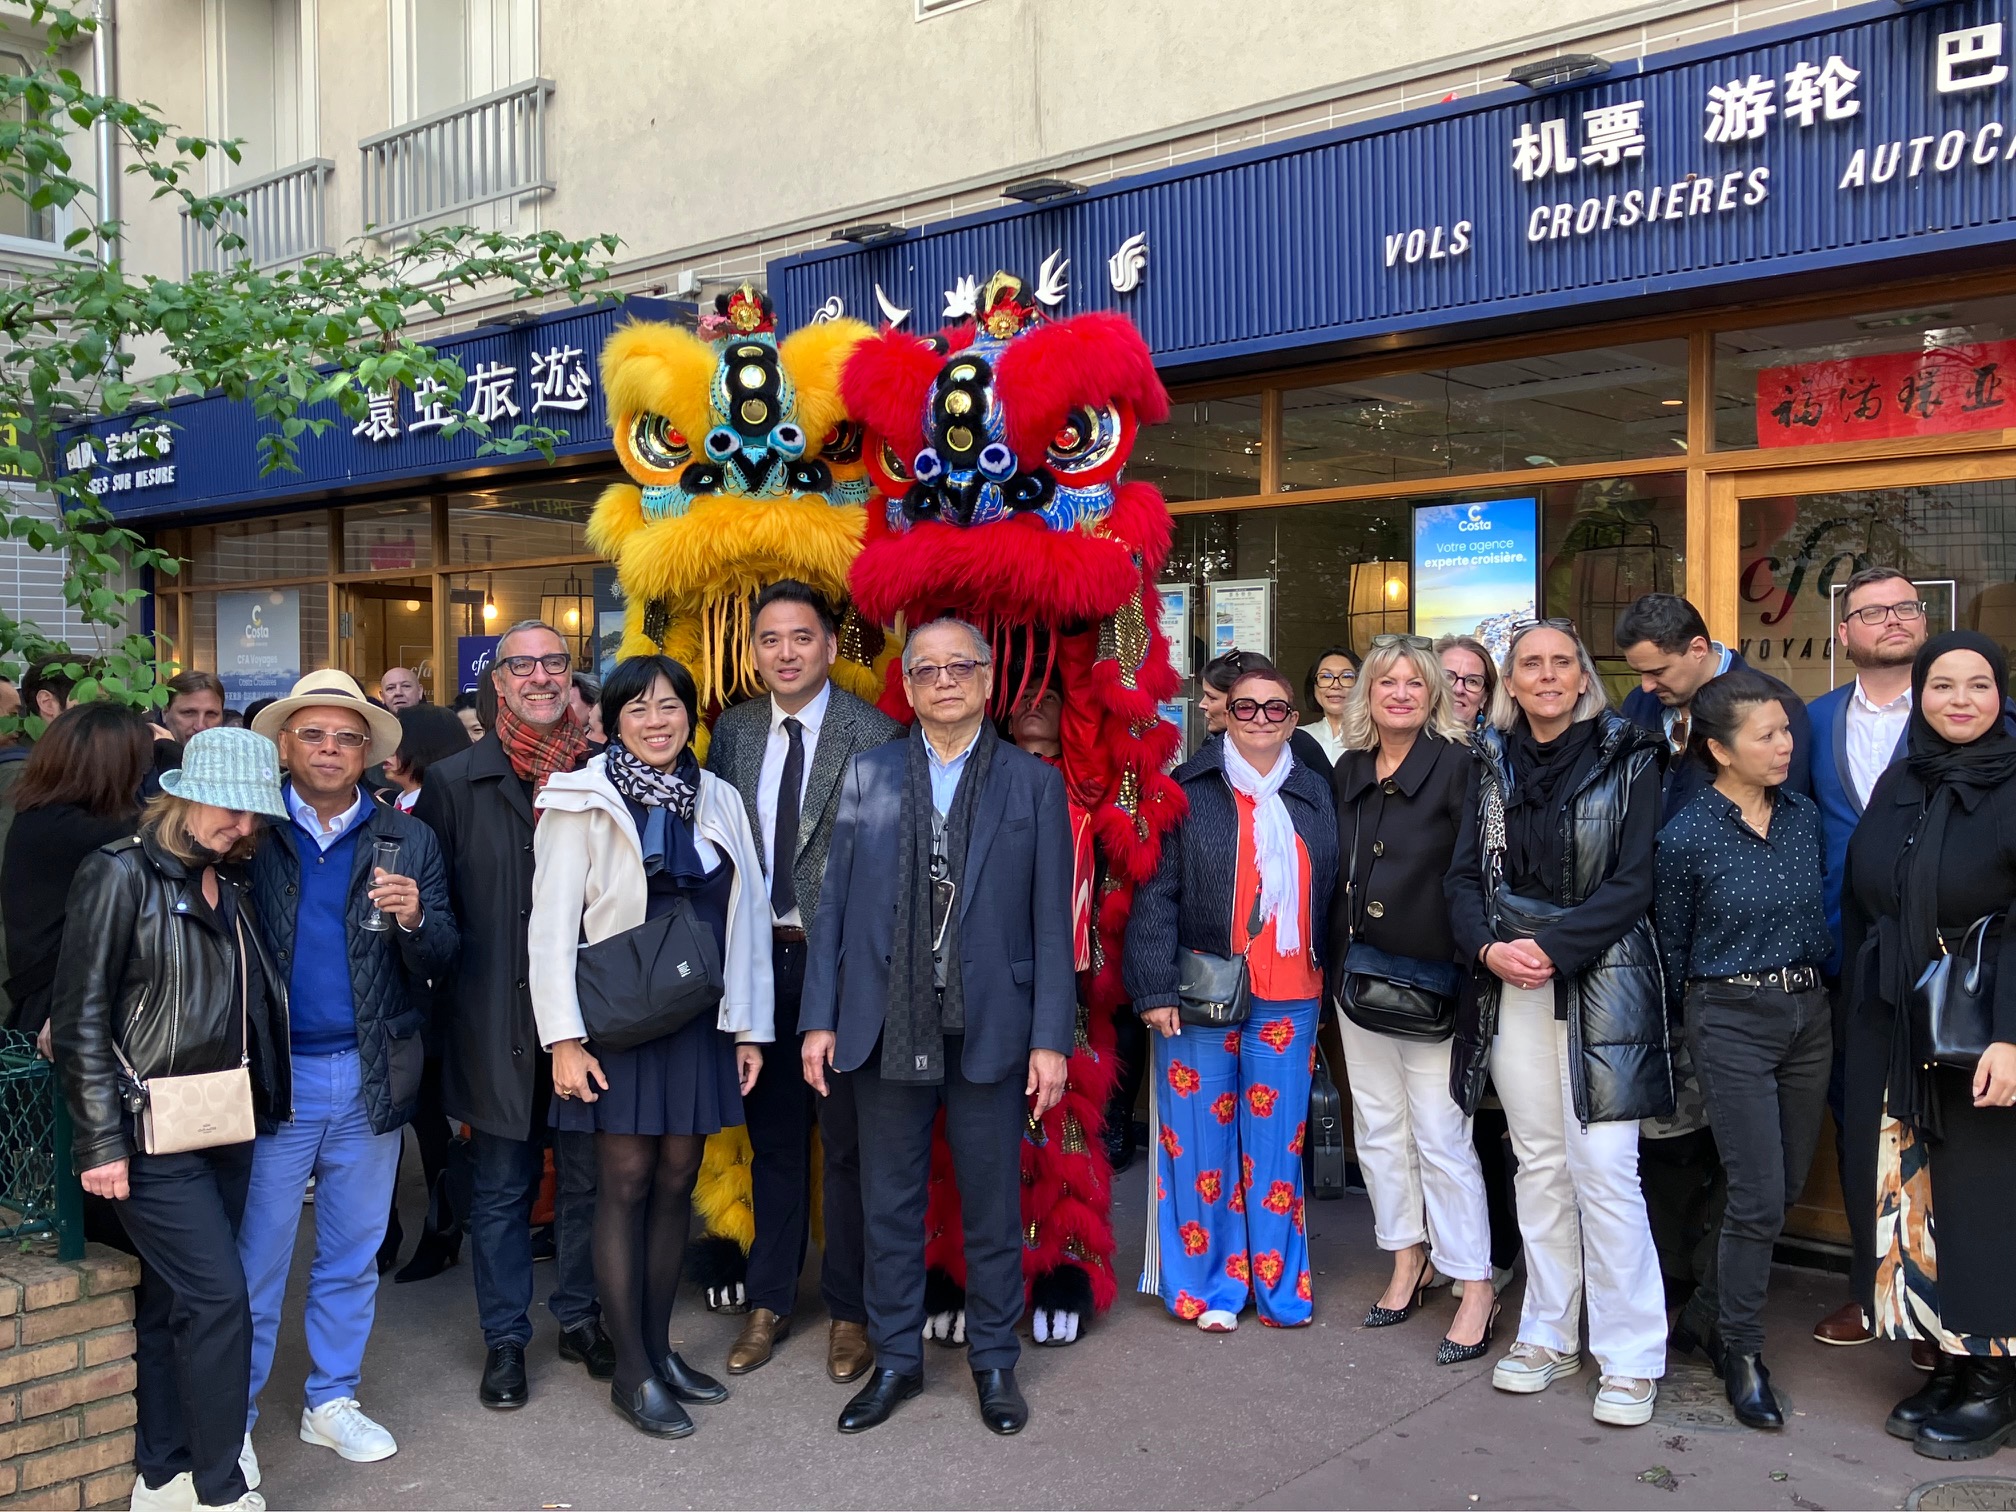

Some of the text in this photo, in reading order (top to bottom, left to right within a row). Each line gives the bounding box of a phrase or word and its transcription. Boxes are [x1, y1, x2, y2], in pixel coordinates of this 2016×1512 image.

[1512, 101, 1645, 182] 机票
[1704, 55, 1862, 143] 游轮
[1385, 220, 1472, 267] VOLS
[112, 473, 132, 491] SUR
[135, 466, 176, 488] MESURE
[1458, 520, 1492, 532] Costa
[1436, 539, 1514, 554] Votre agence
[1424, 551, 1527, 570] experte croisière.
[245, 624, 269, 639] Costa
[1740, 637, 1852, 661] VOYAG
[237, 653, 278, 667] CFA Voyages
